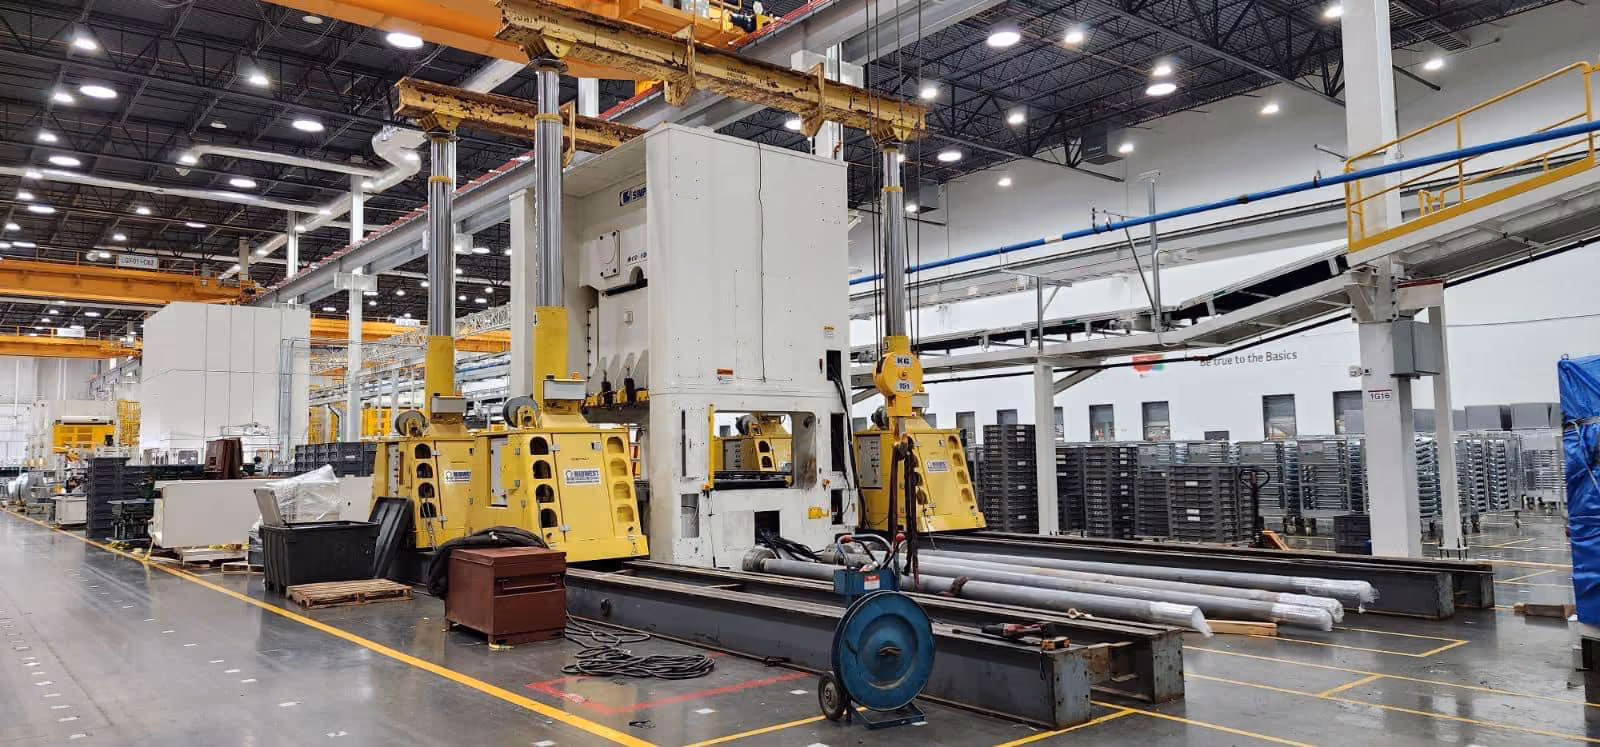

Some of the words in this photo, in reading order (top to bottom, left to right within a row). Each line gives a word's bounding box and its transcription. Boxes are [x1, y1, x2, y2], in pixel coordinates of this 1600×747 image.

[1213, 358, 1233, 366] true
[1235, 355, 1246, 364] to
[1248, 353, 1264, 363] the
[1265, 350, 1298, 362] Basics
